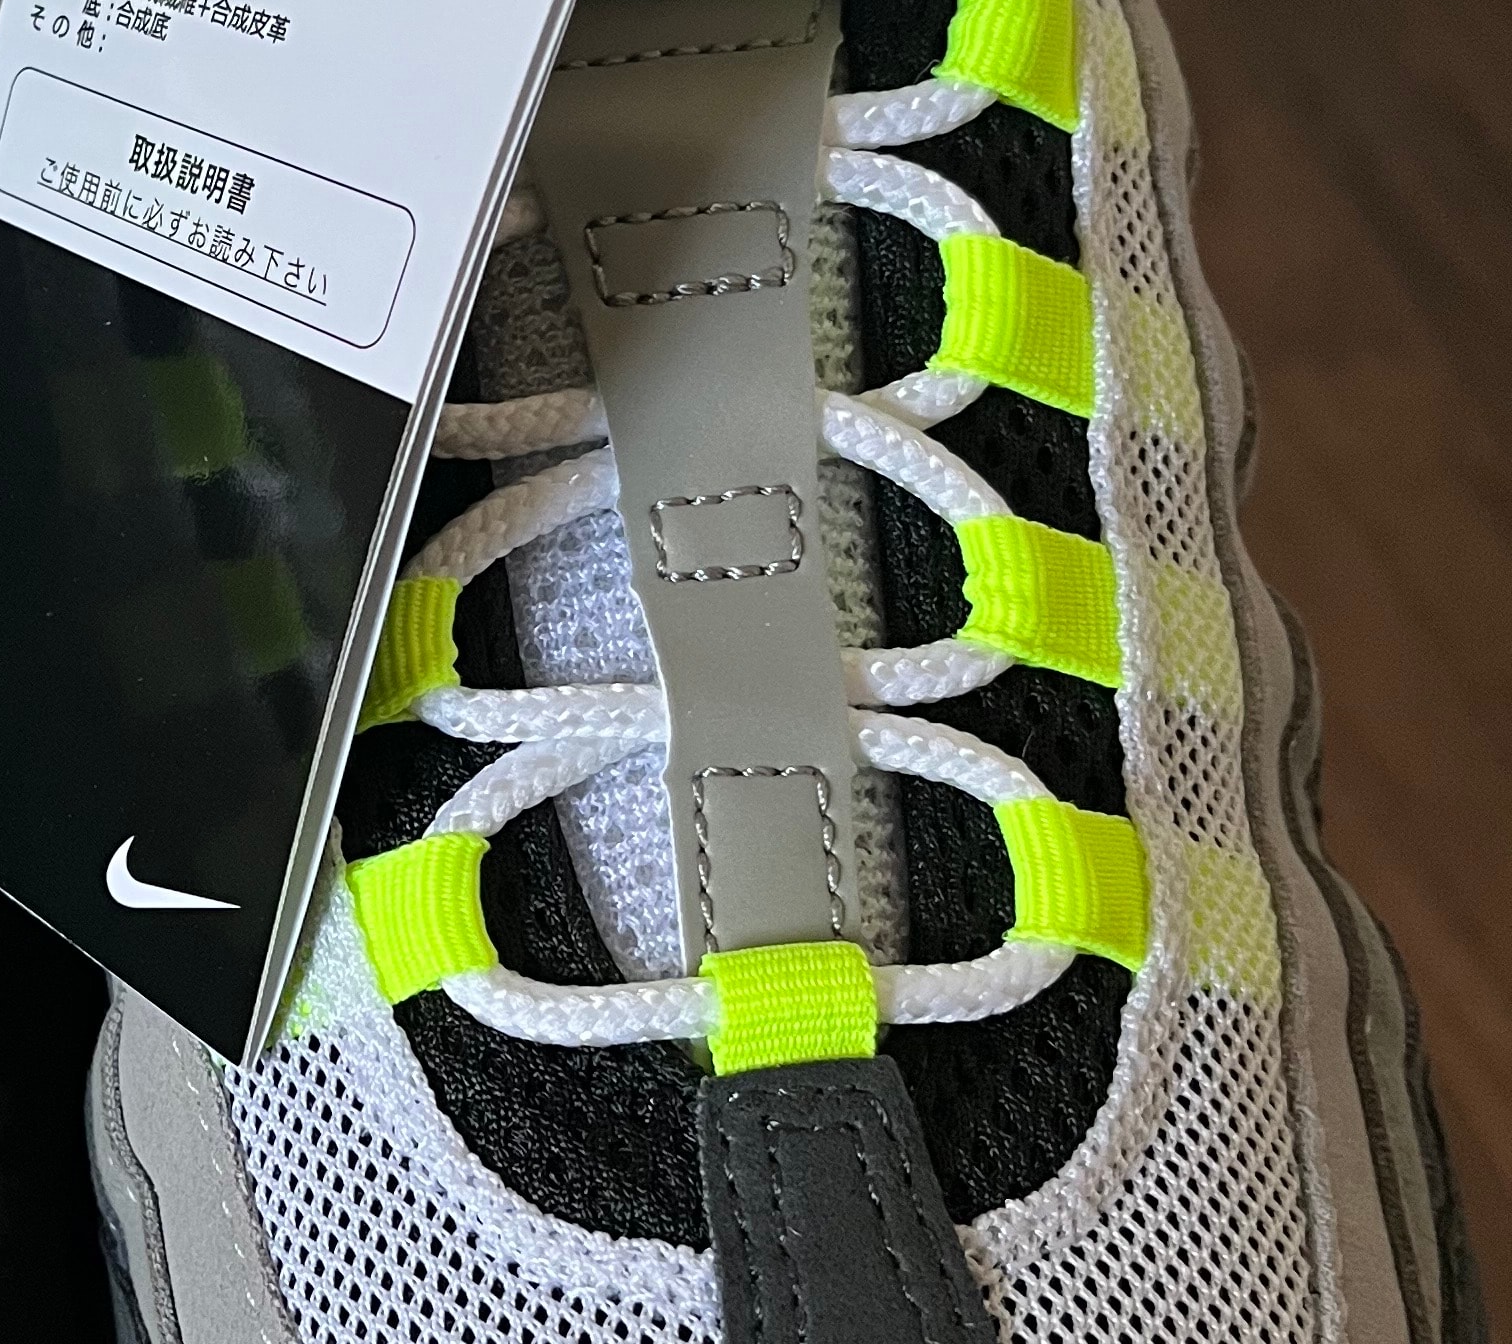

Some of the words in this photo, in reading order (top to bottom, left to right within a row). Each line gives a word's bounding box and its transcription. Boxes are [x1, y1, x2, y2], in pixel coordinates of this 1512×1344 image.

[40, 157, 327, 295] ご使用前に必ずお読み下さい
[129, 134, 256, 215] 取扱説明書
